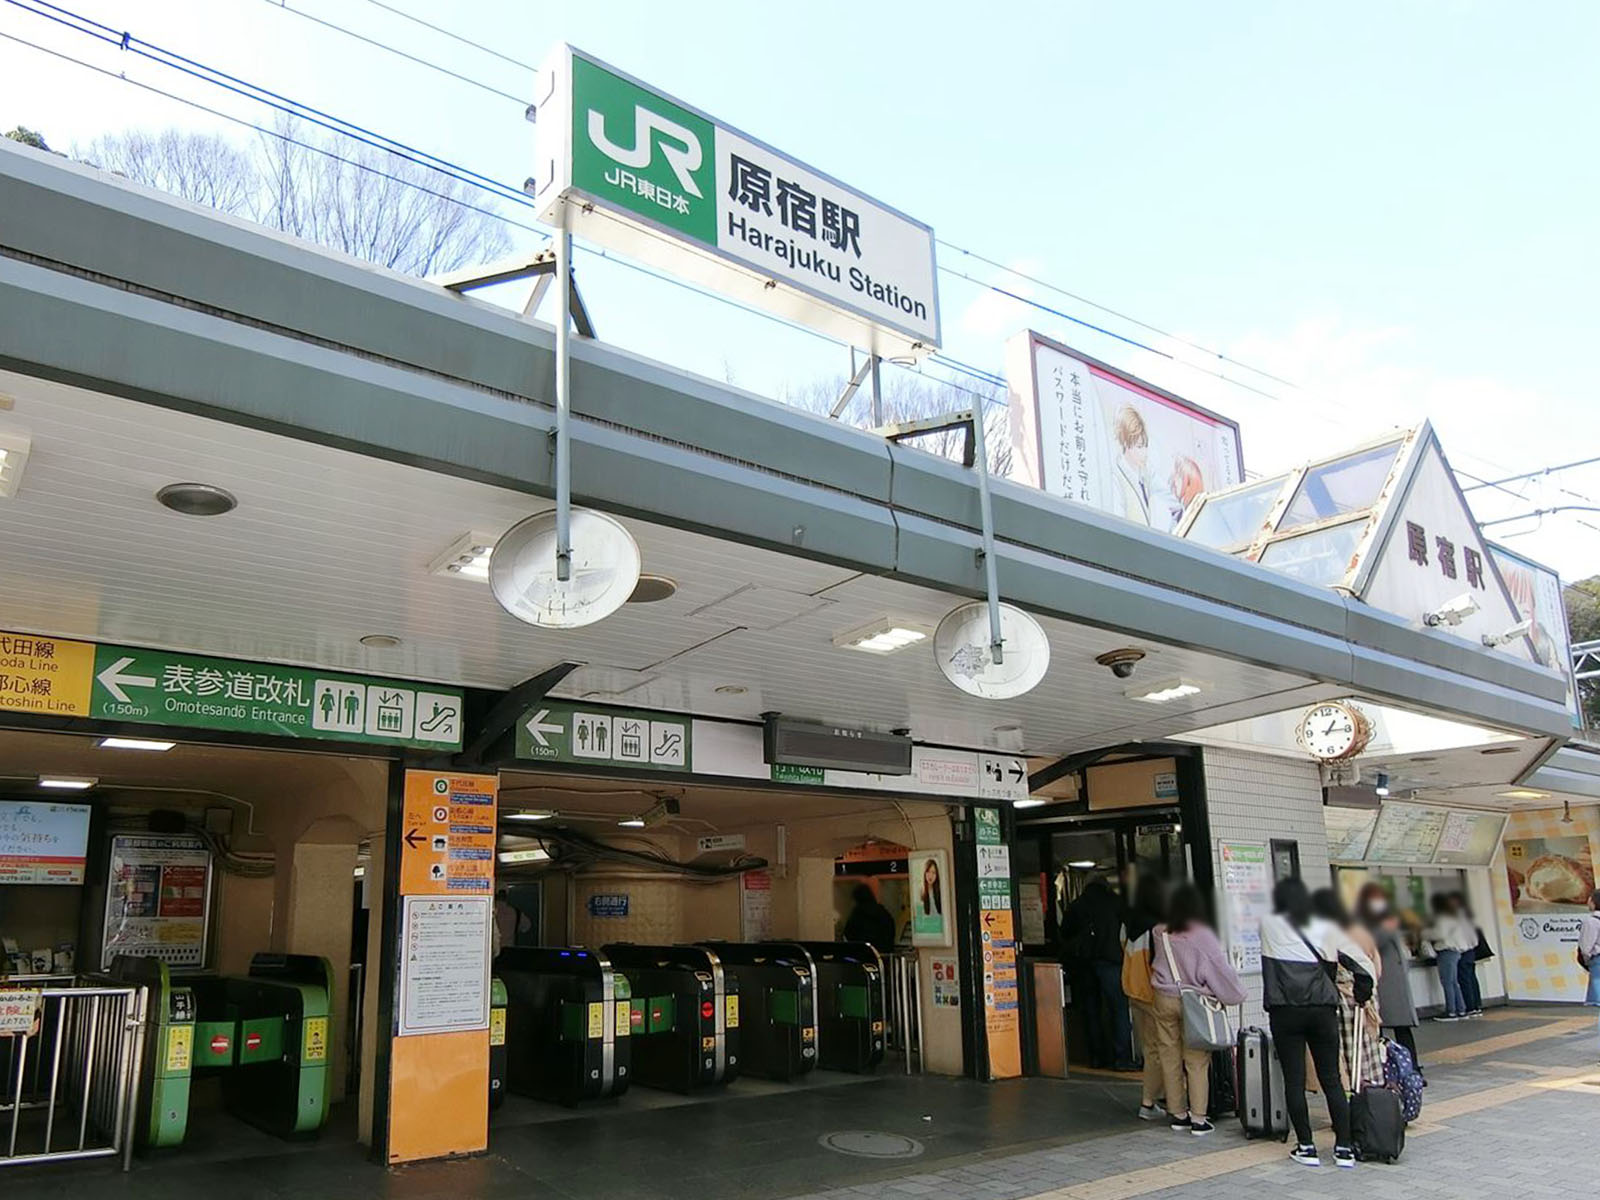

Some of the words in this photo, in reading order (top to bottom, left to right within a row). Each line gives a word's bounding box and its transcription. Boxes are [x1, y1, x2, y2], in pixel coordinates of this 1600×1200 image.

[587, 104, 704, 200] JR
[604, 166, 691, 216] JR東日本
[727, 152, 863, 260] 原宿駅
[728, 212, 842, 284] Harajuku
[848, 267, 928, 321] Station
[1406, 520, 1486, 591] 原宿駅
[30, 659, 59, 673] Line
[162, 664, 310, 707] 表参道改札
[47, 698, 76, 712] Line
[102, 702, 149, 717] (150m)
[1320, 708, 1332, 717] 12
[252, 706, 306, 725] Entrance
[1306, 729, 1314, 738] 9
[1344, 724, 1352, 733] 3
[530, 745, 559, 758] (150m)
[1327, 745, 1335, 754] 6
[890, 861, 897, 873] 2
